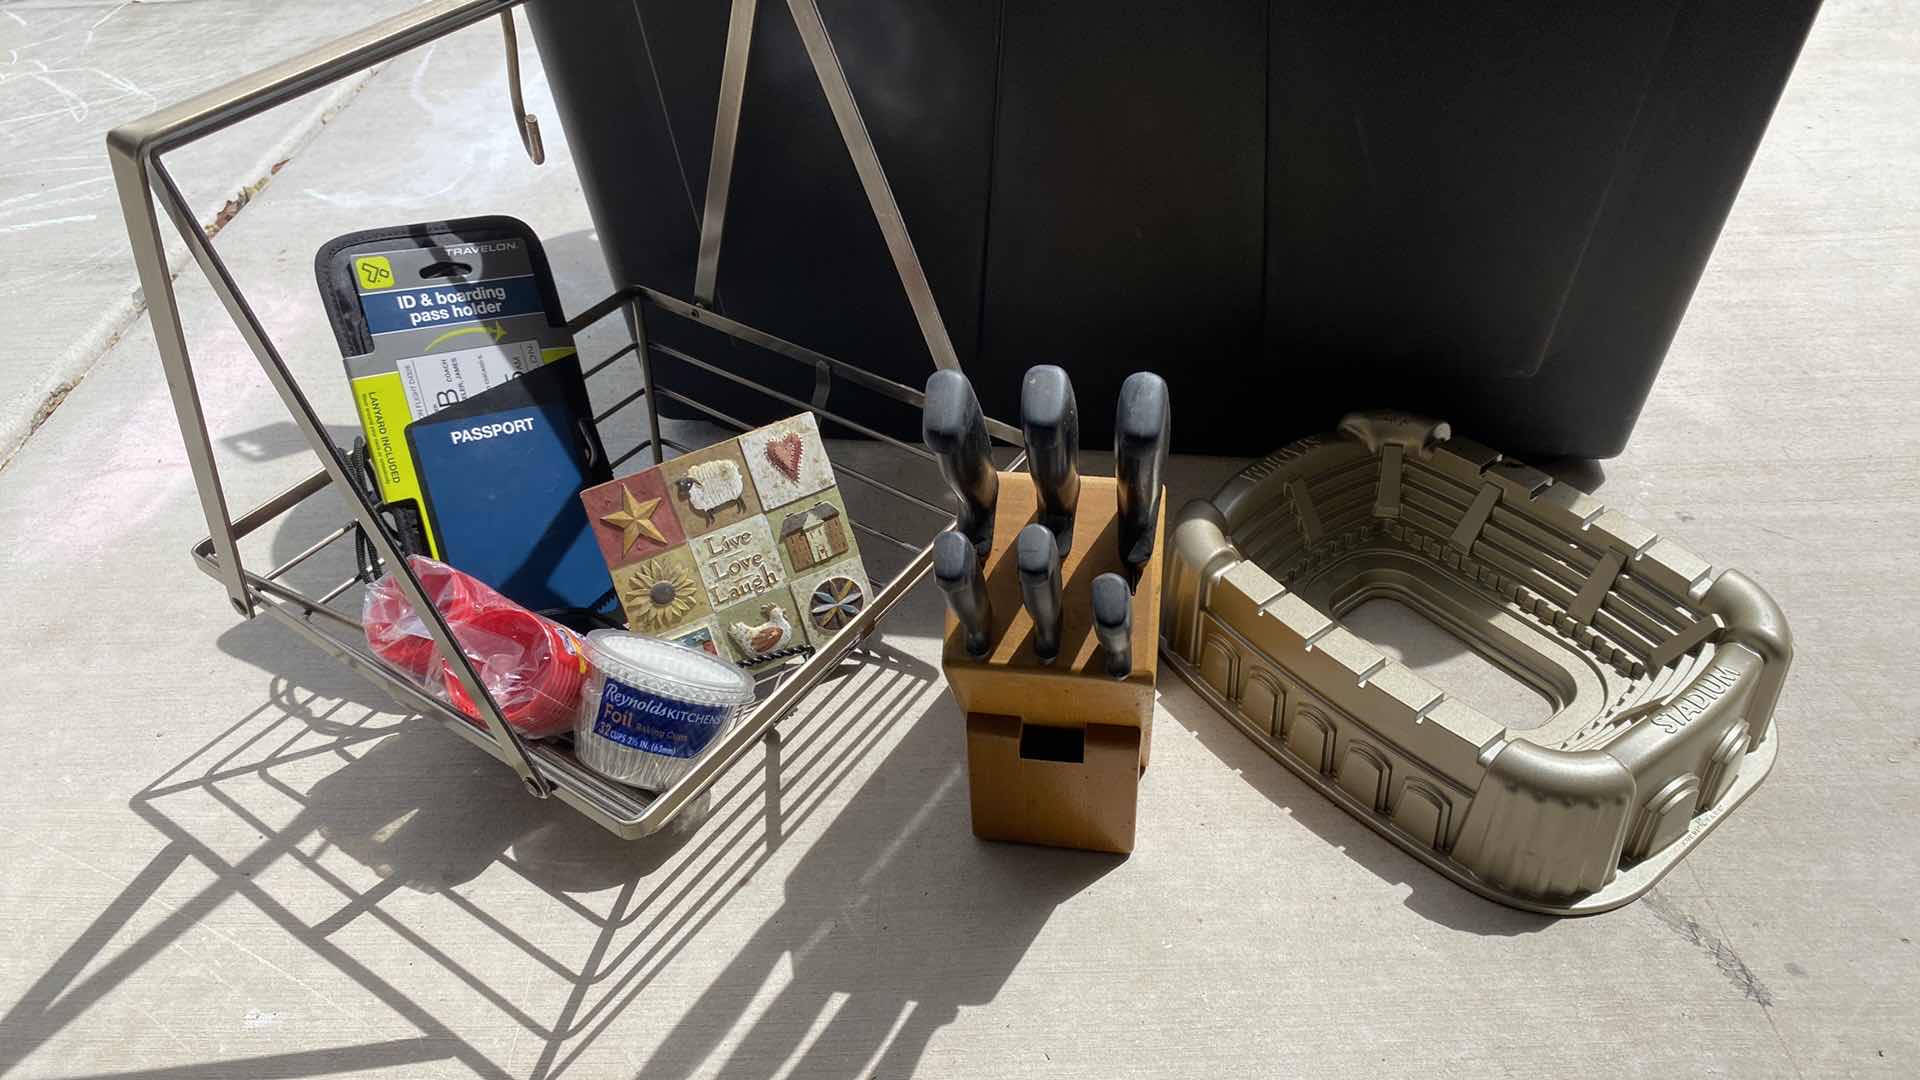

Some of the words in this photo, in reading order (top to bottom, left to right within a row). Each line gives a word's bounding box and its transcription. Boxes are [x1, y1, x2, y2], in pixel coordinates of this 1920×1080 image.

[445, 242, 517, 256] TRAVELON
[397, 294, 416, 309] ID
[420, 293, 434, 306] &
[435, 287, 506, 305] boarding
[409, 308, 450, 326] pass
[451, 301, 502, 317] holder
[441, 359, 452, 383] COACH
[368, 391, 388, 434] LANYARD
[381, 436, 401, 484] INCLUDED
[450, 417, 534, 445] PASSPORT
[704, 531, 752, 557] Live
[709, 554, 762, 580] Love
[709, 563, 778, 606] Laugh
[1650, 664, 1741, 735] STADIUM
[604, 703, 633, 727] Foil
[599, 721, 612, 737] 32
[610, 730, 626, 743] CUPS
